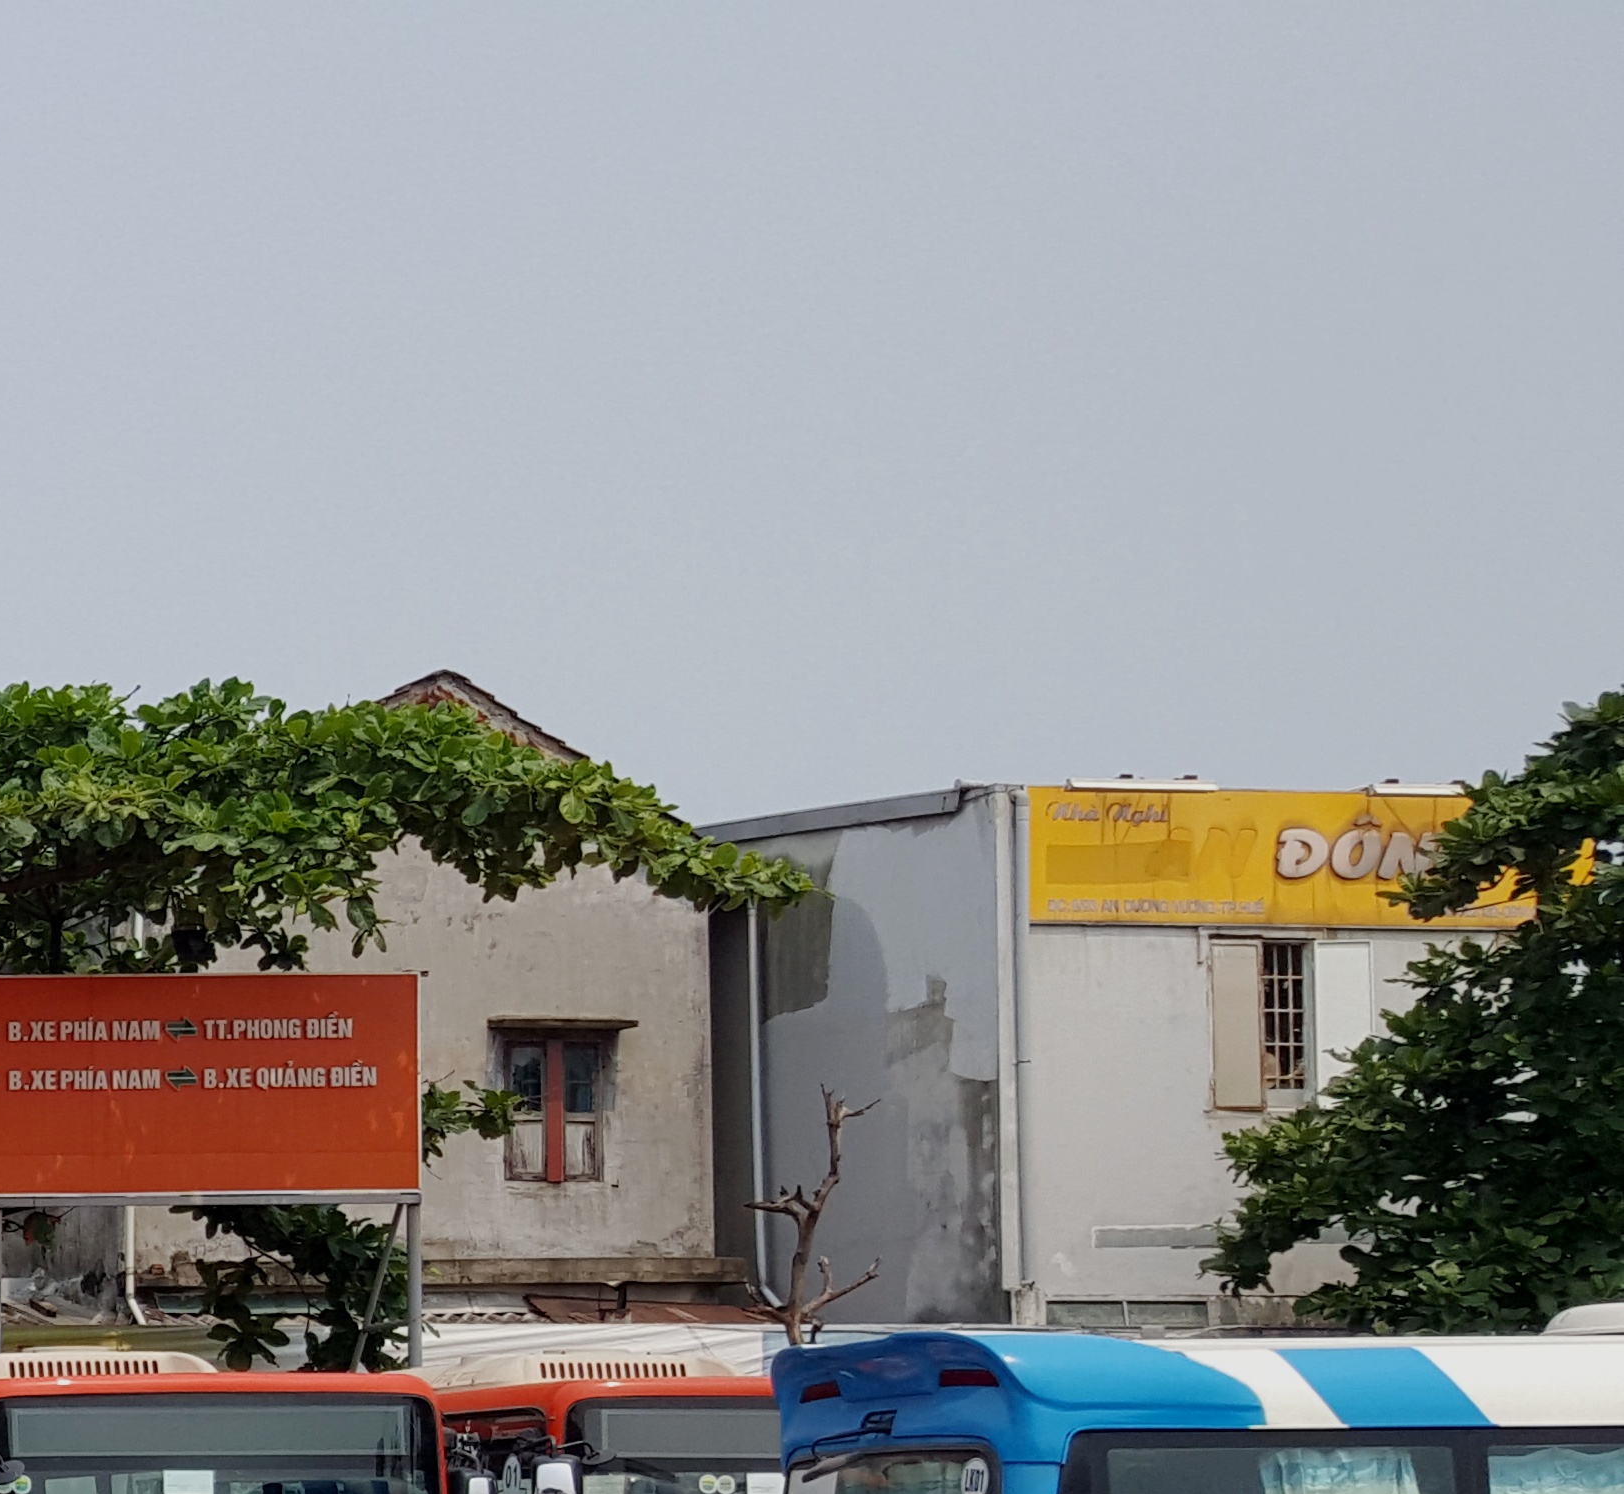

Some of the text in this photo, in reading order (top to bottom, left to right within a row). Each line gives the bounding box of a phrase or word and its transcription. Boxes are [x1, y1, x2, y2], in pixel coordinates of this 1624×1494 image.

[7, 1021, 56, 1042] B.XE
[59, 1016, 109, 1042] PHÍA
[111, 1020, 162, 1042] NAM
[203, 1011, 353, 1041] TT.PHONG ĐIỀN
[7, 1069, 56, 1091] B.XE
[59, 1065, 109, 1091] PHÍA
[111, 1069, 162, 1090] NAM
[203, 1059, 378, 1090] B.XE QUẢNG ĐIỀN
